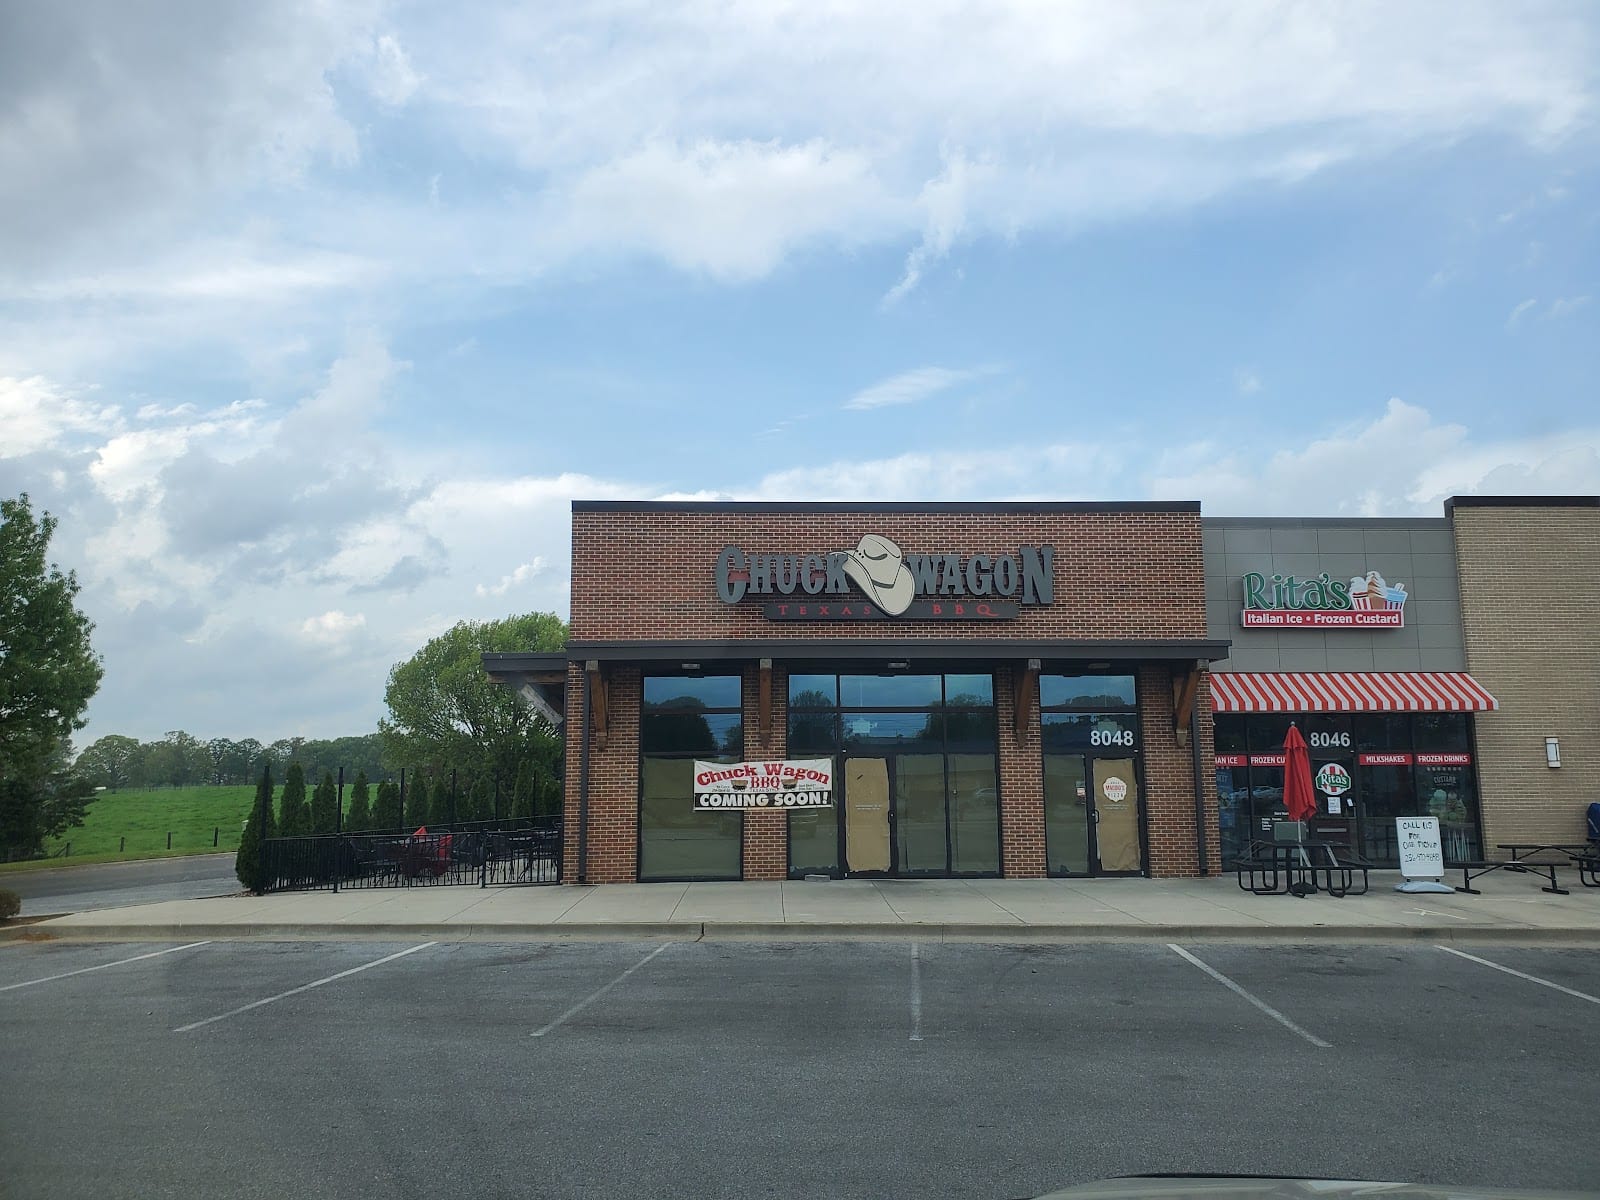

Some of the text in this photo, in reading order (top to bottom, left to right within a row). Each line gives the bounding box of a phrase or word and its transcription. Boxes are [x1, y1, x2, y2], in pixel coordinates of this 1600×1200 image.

[715, 544, 1055, 605] CHUCK WAGON
[1242, 572, 1352, 610] Rita's
[778, 604, 1000, 618] TEXAS BBQ
[1247, 613, 1400, 624] Italian Ice Frozen Custard
[1090, 730, 1134, 747] 8048
[1310, 732, 1351, 747] 8046
[1227, 756, 1238, 764] ICE
[1250, 756, 1286, 764] FROZEN CU
[1366, 755, 1406, 763] MILKSHAKES
[1418, 755, 1468, 763] FROZEN DRINKS
[696, 763, 830, 786] Chuck Wagon
[750, 776, 780, 790] BBQ
[700, 791, 828, 807] COMING SOON!
[1402, 821, 1421, 830] CALL
